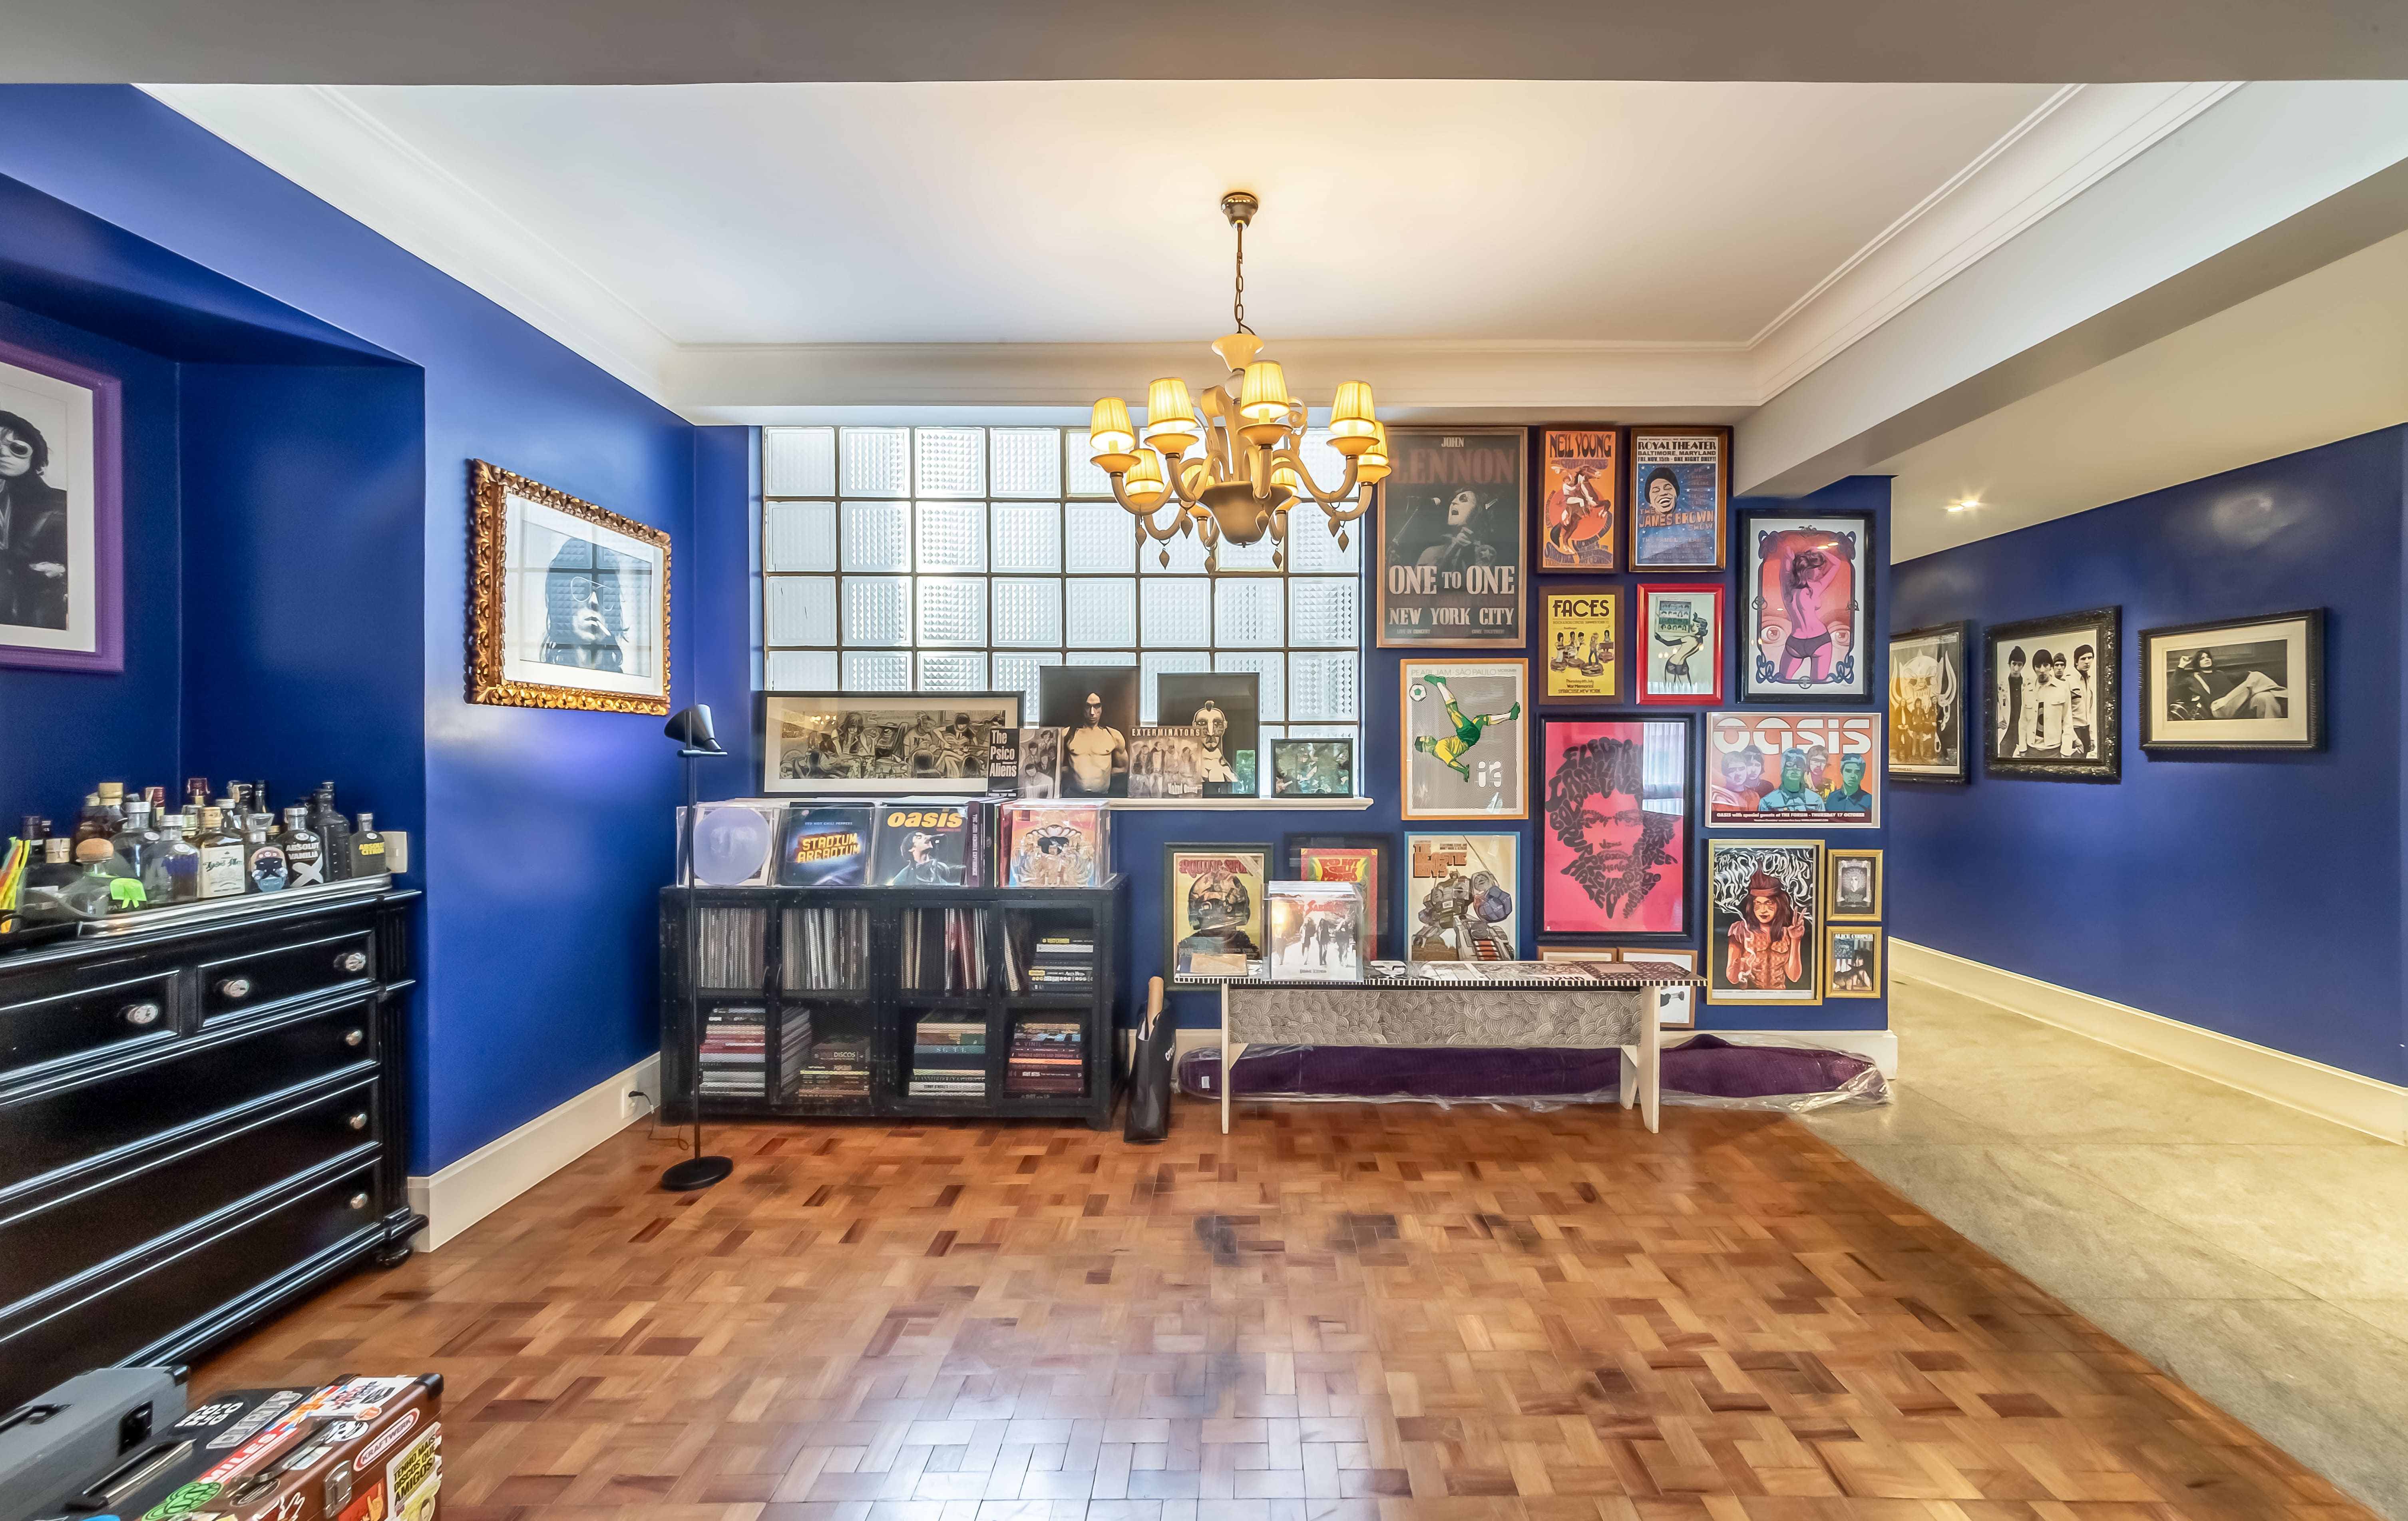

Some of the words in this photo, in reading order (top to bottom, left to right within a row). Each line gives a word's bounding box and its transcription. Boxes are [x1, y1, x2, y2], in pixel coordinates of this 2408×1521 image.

[1441, 437, 1464, 447] JOHN
[1550, 434, 1574, 458] NEIL
[1575, 432, 1612, 458] YOUNG
[1638, 441, 1671, 450] ROYAL
[1672, 441, 1716, 450] THEATER
[1389, 448, 1515, 484] LENNON
[1639, 513, 1673, 528] JAMES
[1675, 510, 1714, 524] BROWN
[1389, 565, 1437, 595] ONE
[1442, 571, 1461, 589] TO
[1466, 565, 1515, 595] ONE
[1389, 607, 1422, 625] NEW
[1430, 607, 1471, 625] YORK
[1479, 607, 1514, 625] CITY
[1552, 599, 1610, 617] FACES
[991, 730, 1007, 744] The
[990, 746, 1015, 760] Psico
[989, 762, 1017, 777] Aliens
[887, 808, 963, 828] oasis
[286, 842, 320, 852] ABSOLUT
[359, 842, 385, 850] ABSOLUT
[802, 832, 858, 851] STADIUM
[1413, 843, 1431, 853] THE
[797, 844, 860, 863] ARCADIUM
[1413, 852, 1467, 866] BEASTIE
[1413, 863, 1448, 878] BOYS
[173, 1404, 209, 1427] HEY
[183, 1404, 221, 1426] HO
[206, 1391, 303, 1449] DIRTY
[207, 1402, 244, 1425] GO
[361, 1416, 412, 1463] KRAFTWERK
[199, 1433, 277, 1482] MILES
[394, 1453, 416, 1481] TENHO
[418, 1434, 435, 1457] MAIS
[394, 1459, 420, 1493] DISCOS
[422, 1443, 436, 1462] QUE
[395, 1457, 433, 1507] AMIGOS
